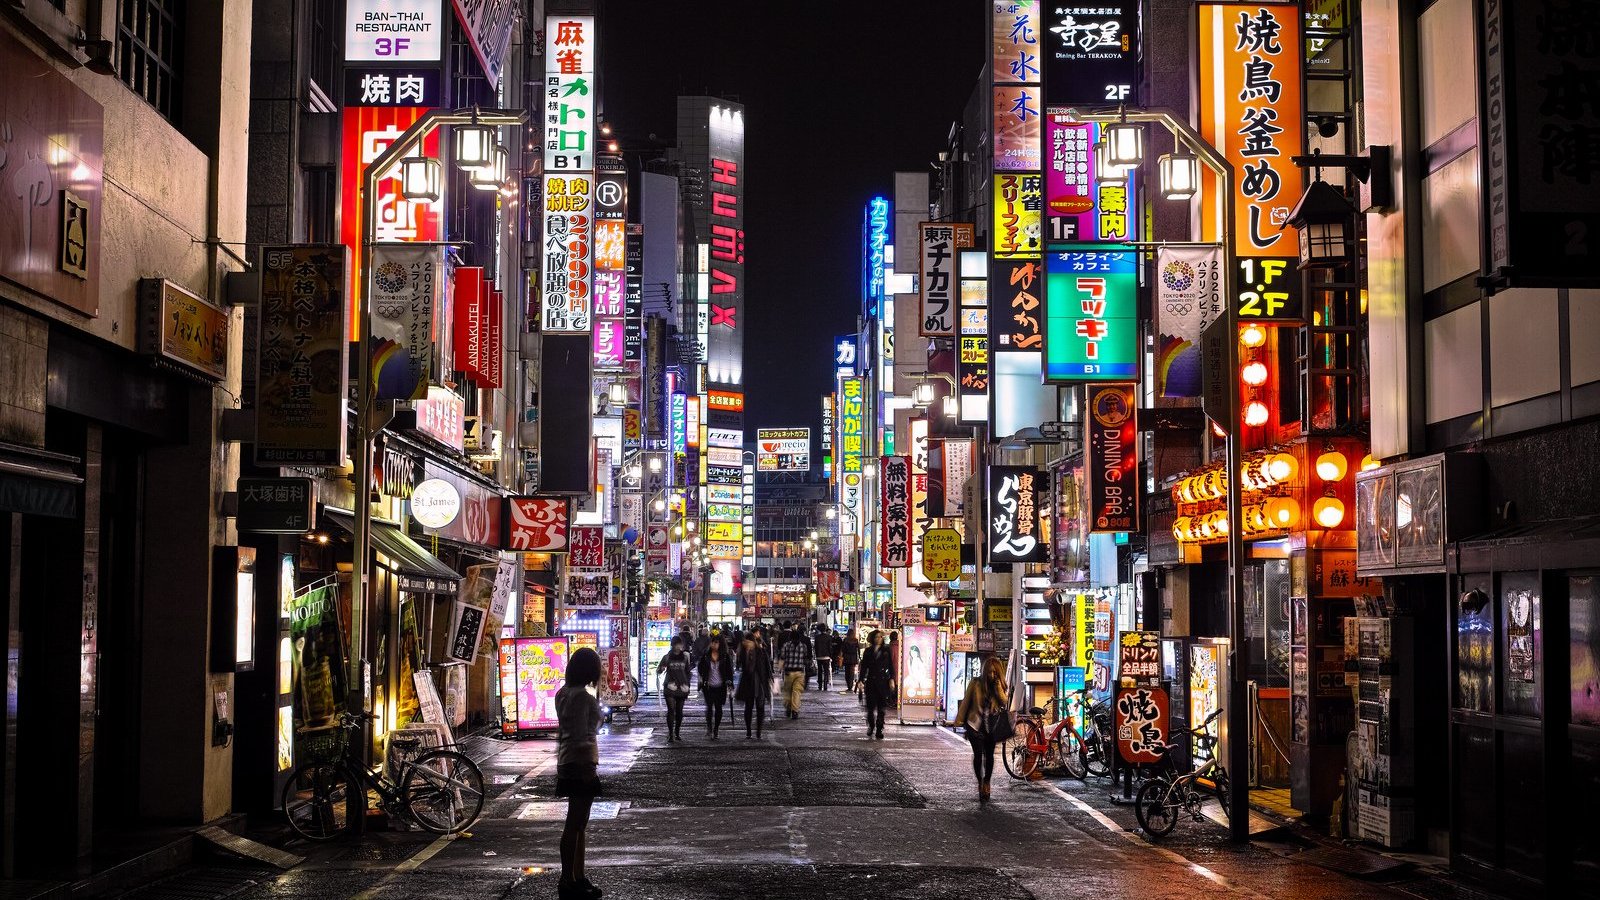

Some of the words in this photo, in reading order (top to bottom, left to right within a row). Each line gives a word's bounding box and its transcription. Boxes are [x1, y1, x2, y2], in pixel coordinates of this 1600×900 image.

[355, 22, 432, 33] RESTAURANT
[364, 12, 425, 21] BAN-THAI
[375, 38, 411, 56] 3F
[554, 20, 585, 75] 麻雀
[1056, 53, 1076, 61] Dining
[1007, 15, 1041, 122] 花水木
[360, 73, 425, 104] 焼肉
[1104, 85, 1131, 100] 2F
[547, 77, 560, 151] 四名様専門店
[1234, 8, 1285, 249] 焼鳥釜めし
[1053, 129, 1065, 172] ホテル可
[1489, 77, 1505, 216] HONJIN
[554, 155, 582, 169] B1
[547, 178, 590, 195] 焼肉
[547, 195, 590, 211] ホルモン
[924, 227, 953, 242] 東京
[1051, 216, 1076, 240] 1F
[268, 250, 294, 269] 5F
[1059, 252, 1124, 261] オンライン
[546, 214, 569, 330] 食べ放題の店
[926, 242, 952, 316] チカラ
[1238, 259, 1288, 286] 1F
[1210, 261, 1221, 314] 2020年
[1238, 290, 1289, 316] 2F
[291, 262, 316, 401] 本格ベトナム料理
[924, 316, 953, 332] めし
[1076, 277, 1108, 361] ラッキー
[467, 303, 479, 369] ANRAKUTEI
[1084, 365, 1101, 373] B1
[1103, 429, 1121, 484] DINING
[244, 484, 306, 503] 大塚歯科
[1018, 473, 1034, 535] 東京豚骨
[1104, 486, 1122, 516] BAR
[286, 514, 303, 528] 4F
[886, 462, 908, 563] 無料案内所
[1122, 647, 1159, 661] ドリンク
[1122, 662, 1159, 676] 全品半額
[1118, 688, 1167, 759] 焼鳥
